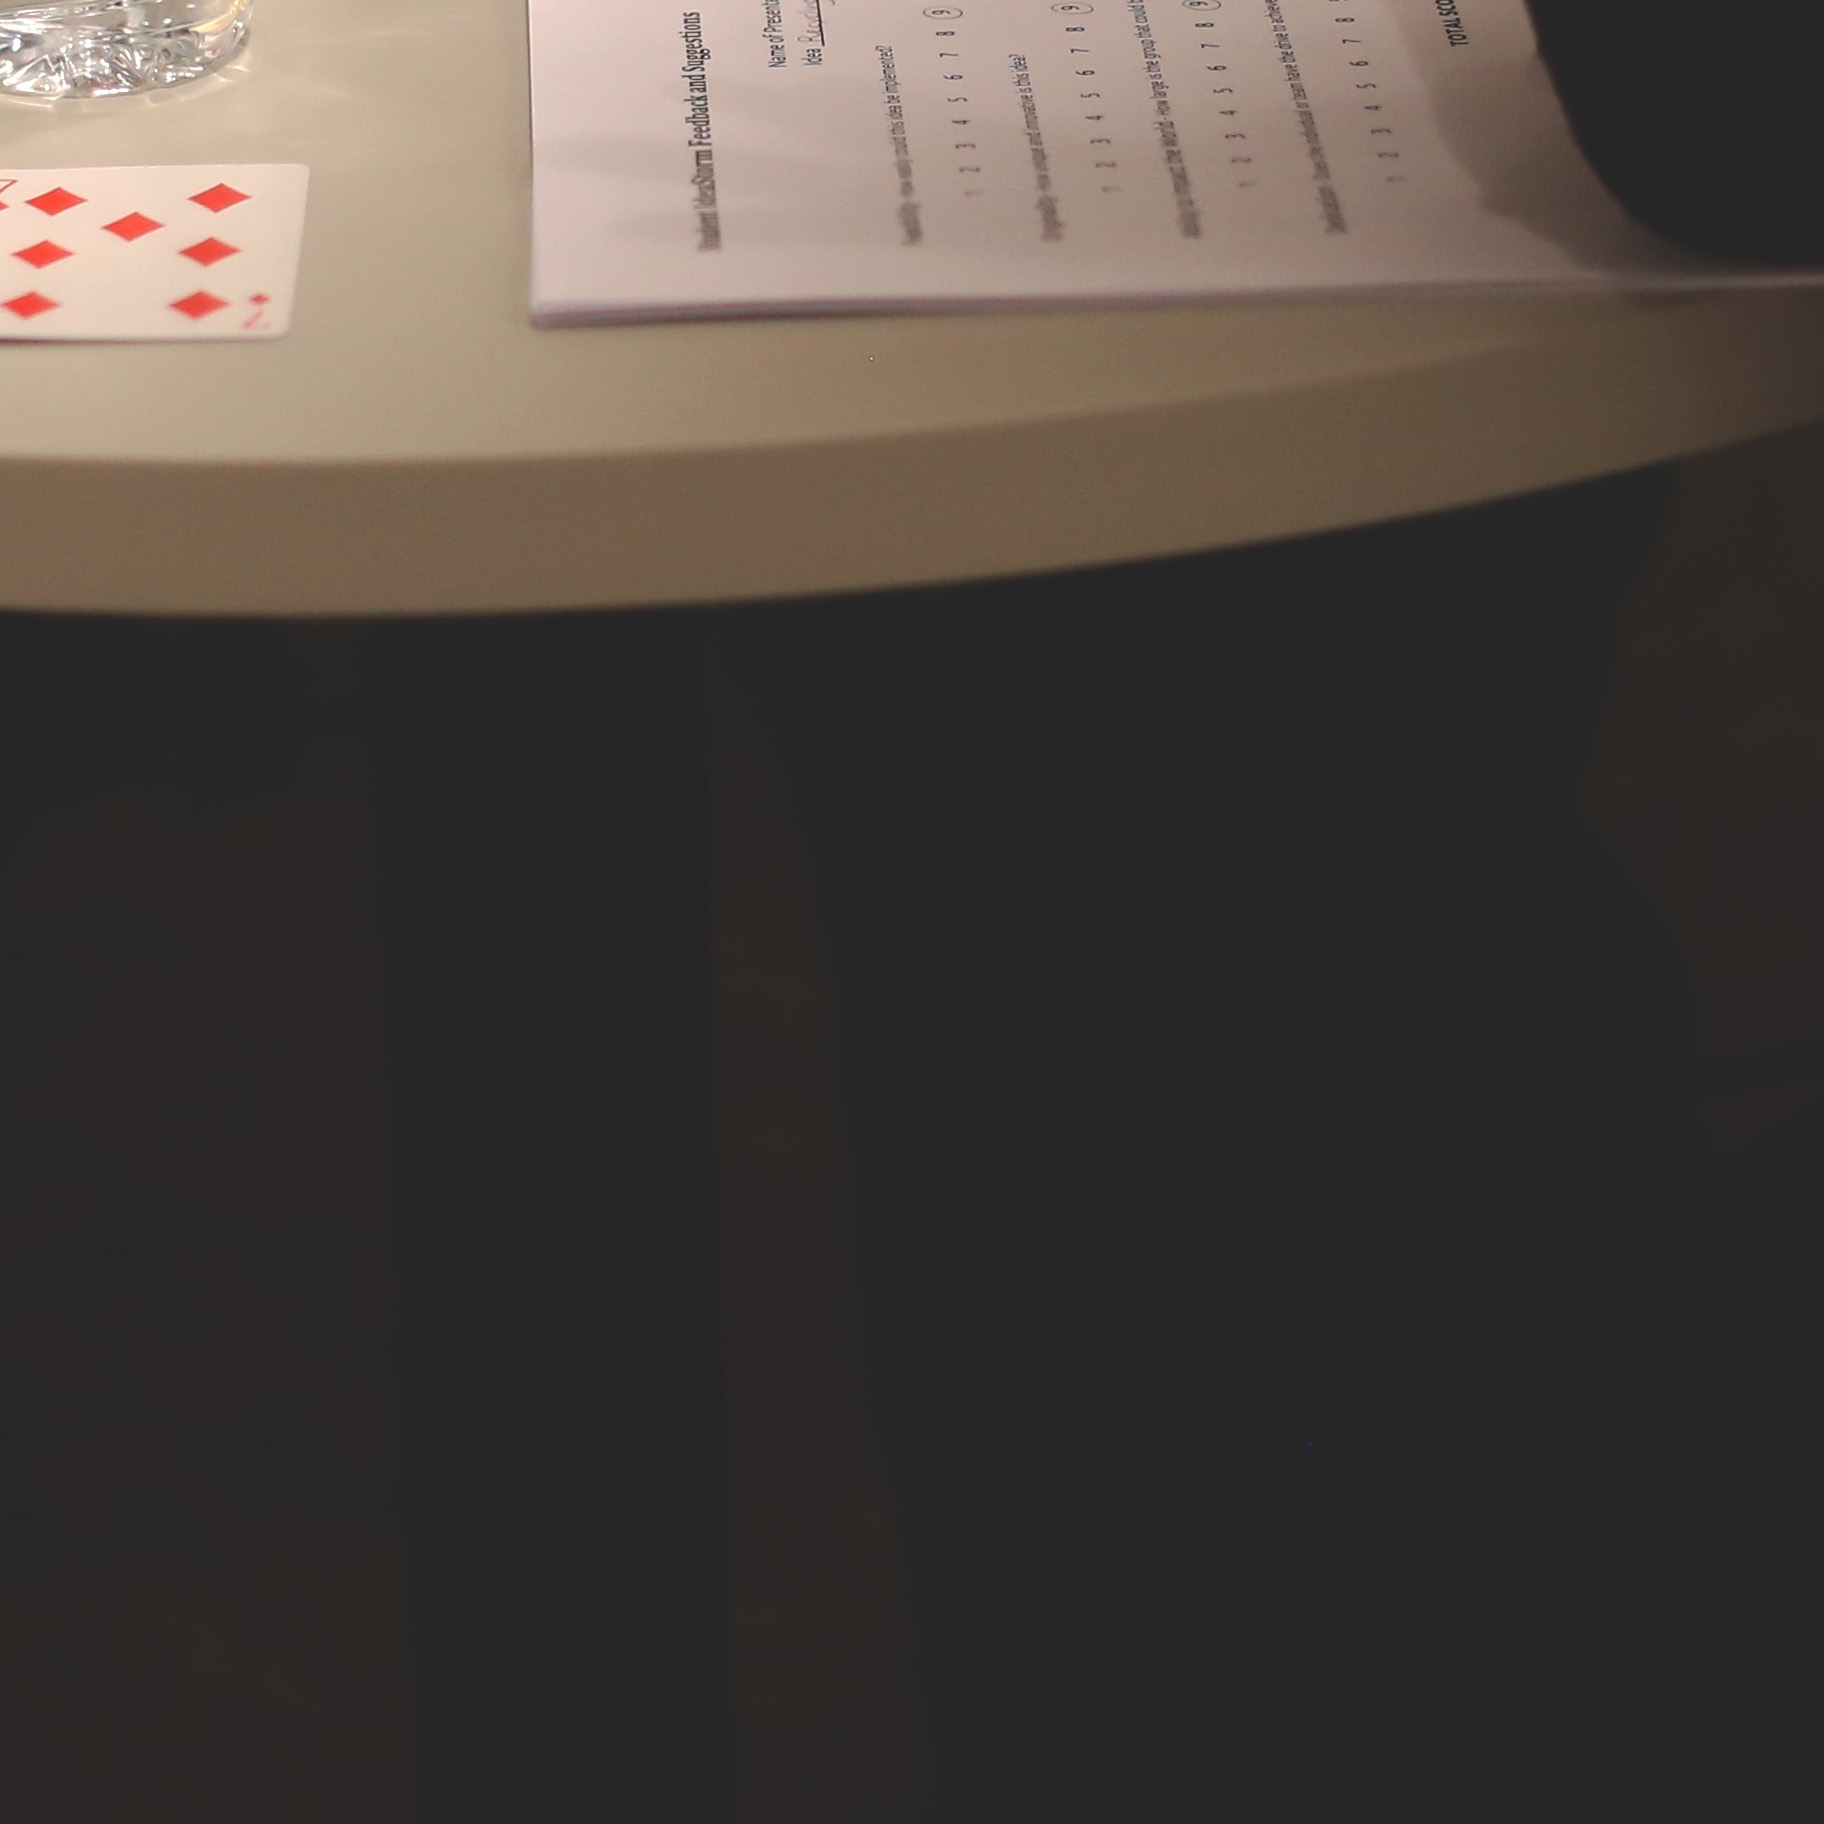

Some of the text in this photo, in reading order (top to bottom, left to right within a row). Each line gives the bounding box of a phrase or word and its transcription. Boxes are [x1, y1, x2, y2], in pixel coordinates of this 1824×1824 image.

[1127, 5, 1148, 23] could
[1134, 24, 1152, 39] that
[1272, 24, 1286, 32] to
[1443, 17, 1469, 46] TOTAL
[678, 11, 711, 72] Suggestions
[762, 33, 783, 42] of
[1275, 33, 1293, 50] drive
[765, 44, 787, 67] Name
[803, 48, 824, 65] Idea
[1140, 40, 1162, 59] group
[1280, 51, 1296, 63] the
[875, 46, 900, 94] implemented?
[1008, 54, 1027, 72] idea?
[1143, 60, 1161, 72] the
[1284, 63, 1300, 81] have
[682, 74, 707, 92] and
[1012, 73, 1032, 86] this
[1149, 81, 1169, 98] large
[884, 95, 902, 104] be
[684, 95, 712, 146] Feedback
[241, 310, 271, 331] 7
